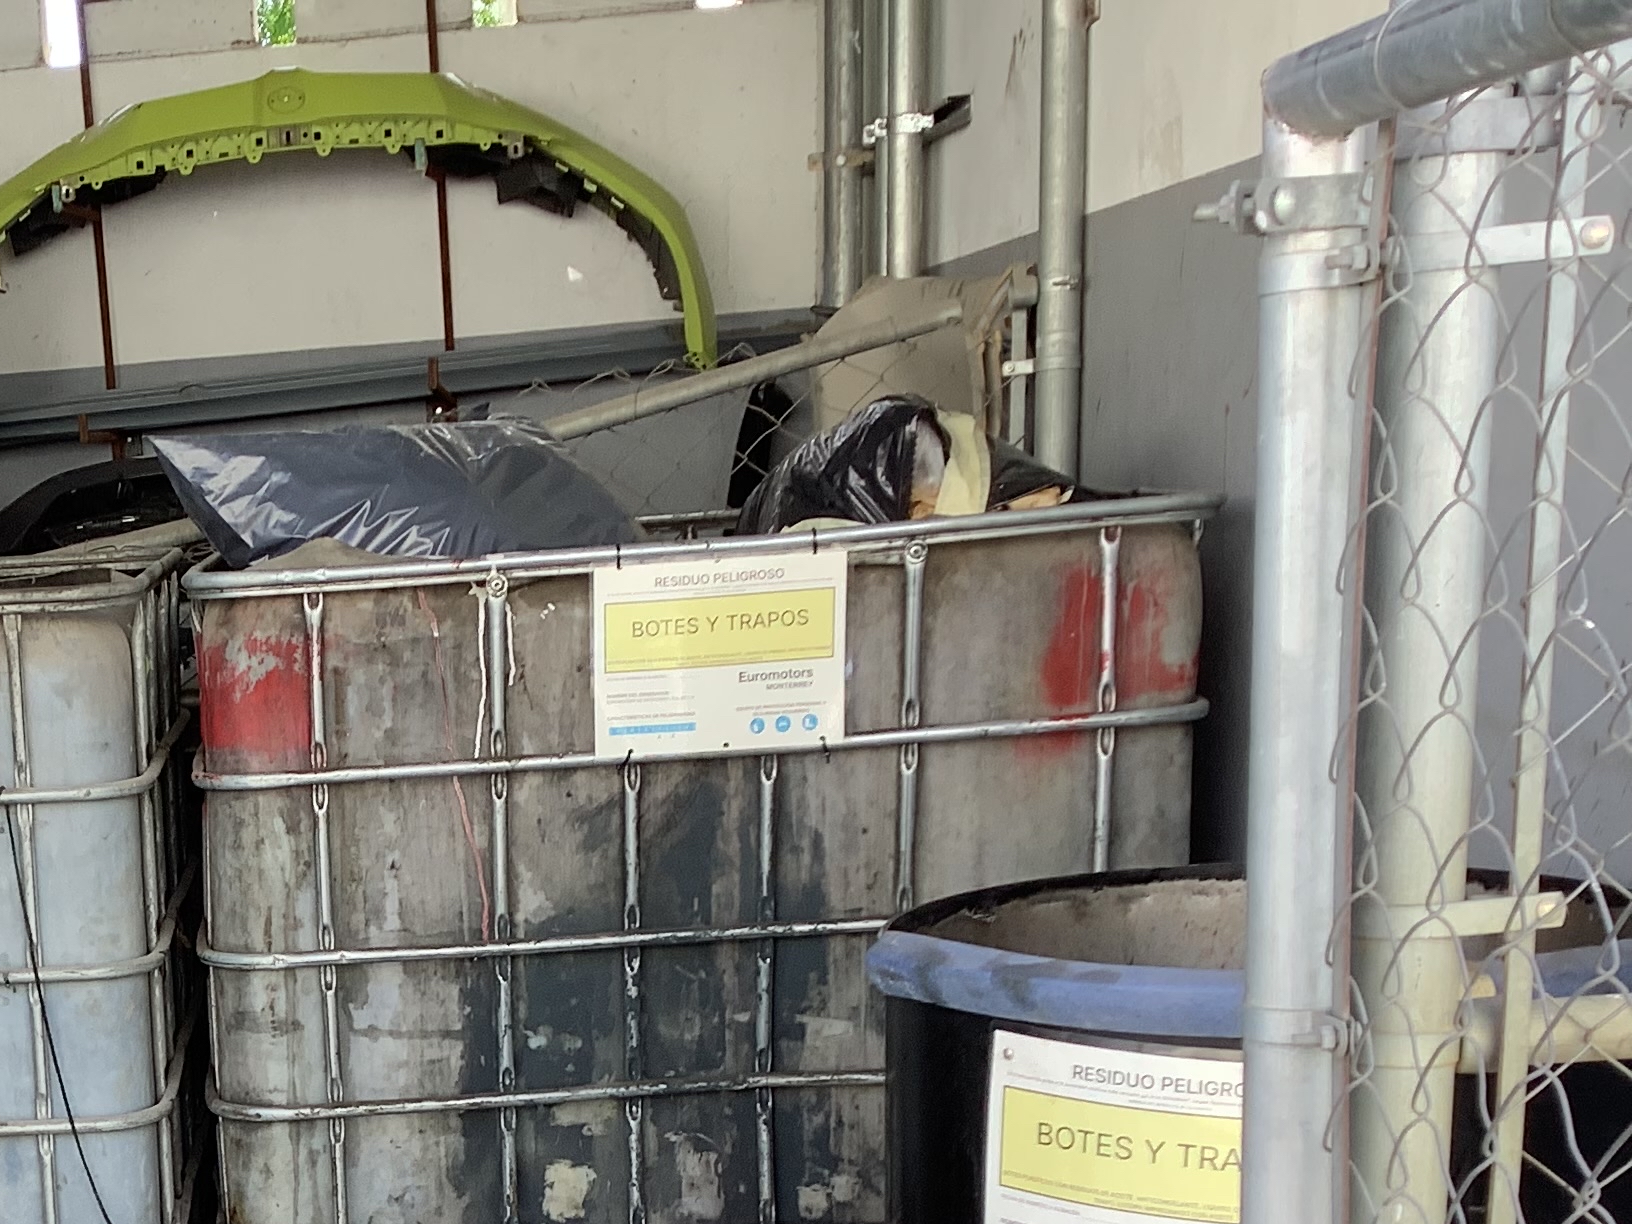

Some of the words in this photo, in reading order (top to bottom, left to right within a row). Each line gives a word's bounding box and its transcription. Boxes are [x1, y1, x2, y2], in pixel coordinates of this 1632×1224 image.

[654, 574, 710, 587] RESIDUO
[713, 568, 785, 583] PELIGROSO
[631, 617, 699, 638] BOTES
[706, 616, 718, 632] Y
[726, 608, 809, 630] TRAPOS
[738, 667, 814, 683] Euromotors
[766, 680, 814, 690] MONTERREY
[1072, 1064, 1155, 1090] RESIDUO
[1161, 1077, 1243, 1098] PELIGRO
[1037, 1122, 1133, 1160] BOTES
[1145, 1139, 1166, 1164] Y
[1177, 1143, 1241, 1172] TRA
